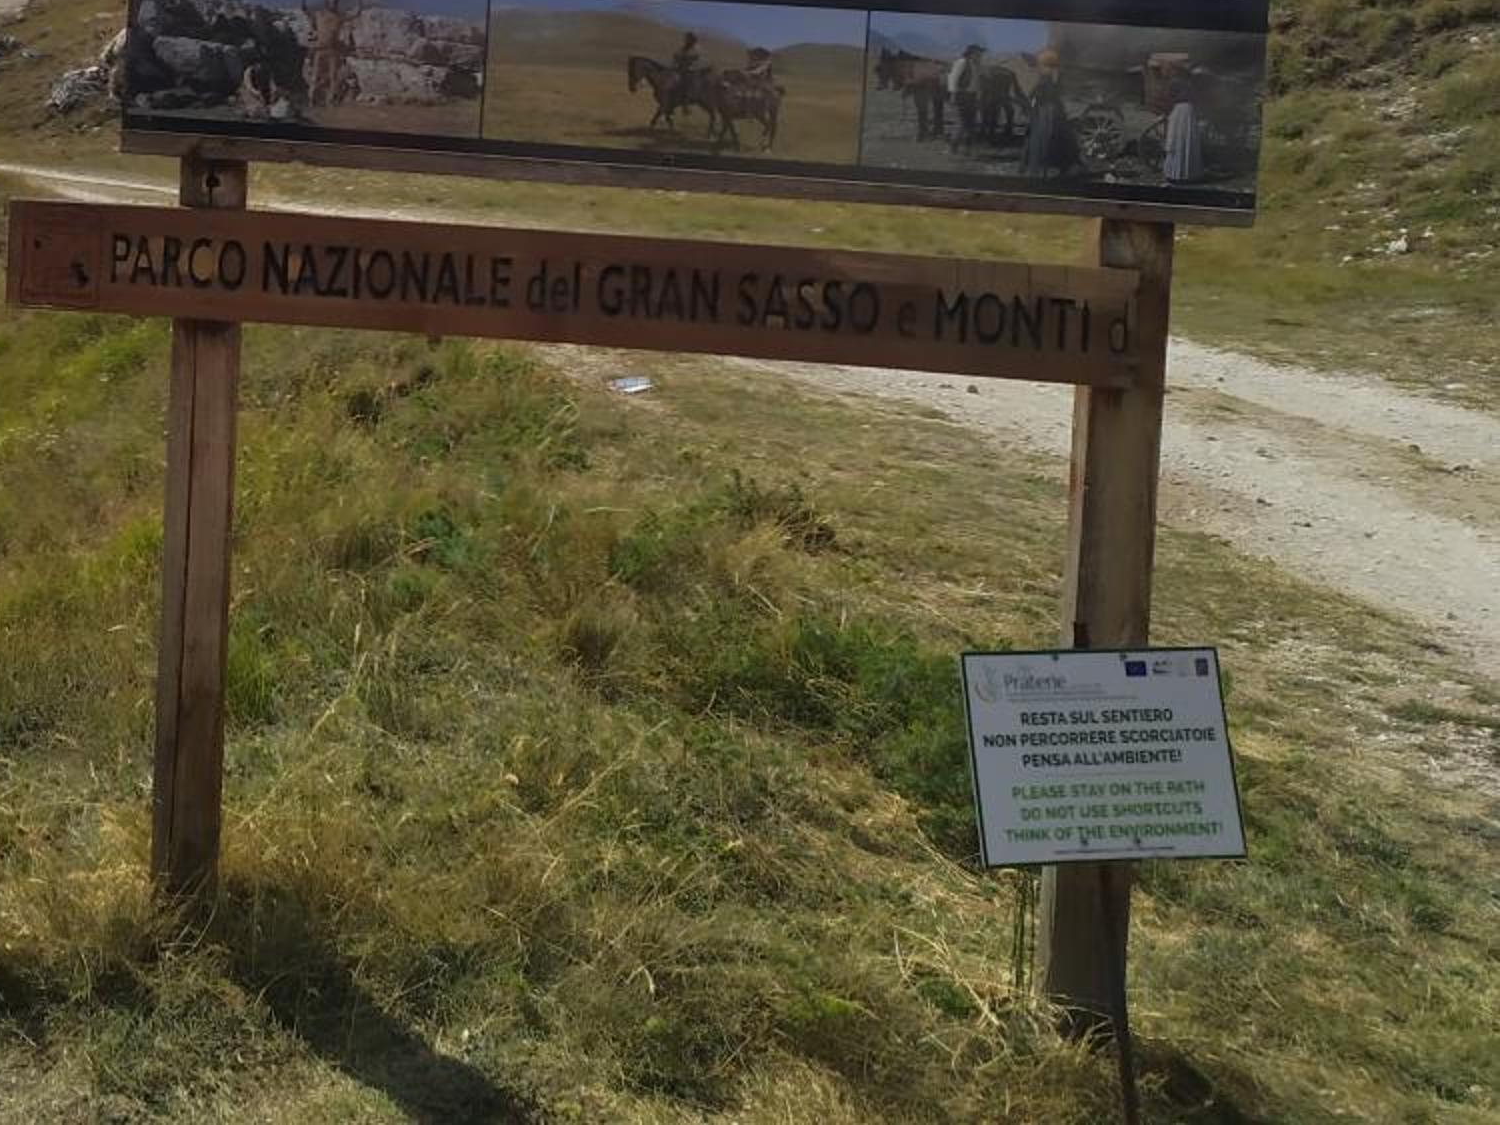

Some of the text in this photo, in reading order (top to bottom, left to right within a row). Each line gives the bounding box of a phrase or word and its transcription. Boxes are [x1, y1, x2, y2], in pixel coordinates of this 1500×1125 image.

[109, 232, 248, 292] PARCO
[261, 240, 512, 307] NAZIONALE
[525, 260, 582, 316] del
[597, 264, 721, 324] GRAN
[736, 271, 881, 335] SASSO
[895, 305, 918, 338] e
[933, 287, 1092, 354] MONTI
[1019, 708, 1174, 727] RESTA SUL SENTIERO
[982, 727, 1218, 748] NON PERCORRERE SCORCIATOIE
[1021, 749, 1183, 768] PENSA ALL'AMBIENTE!
[1011, 779, 1206, 800] PLEASE STAY ON THE PATH
[1020, 800, 1204, 822] DO NOT USE SHORTCUTS
[1004, 827, 1051, 843] THINK
[1053, 826, 1073, 841] OF
[1076, 825, 1108, 841] THE
